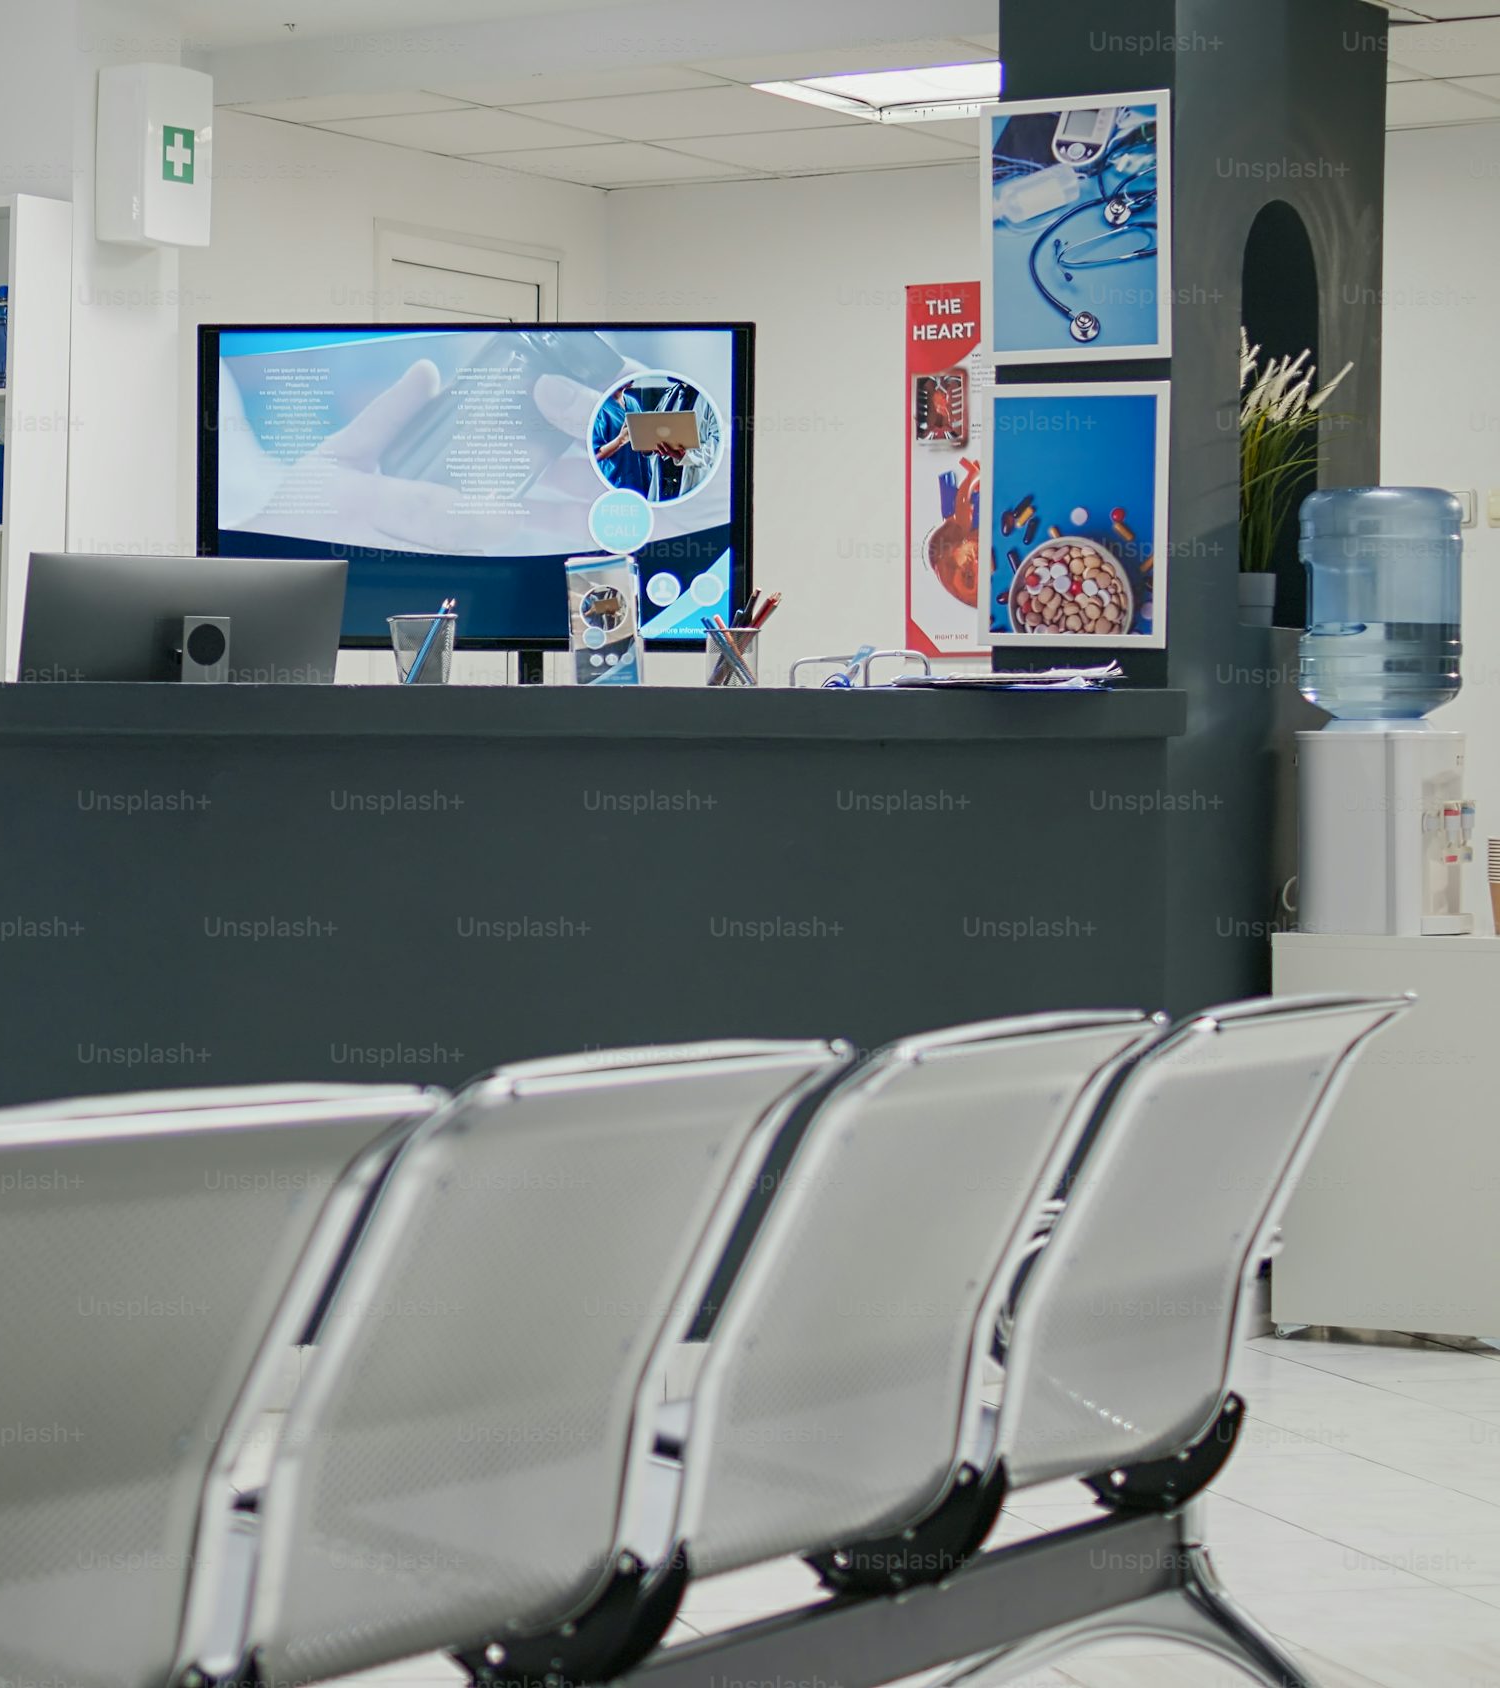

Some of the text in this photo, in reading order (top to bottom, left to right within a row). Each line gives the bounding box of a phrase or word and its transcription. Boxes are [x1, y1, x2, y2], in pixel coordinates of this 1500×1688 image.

[926, 298, 962, 316] THE
[913, 322, 975, 341] HEART
[601, 504, 639, 518] FREE
[604, 524, 639, 537] CALL
